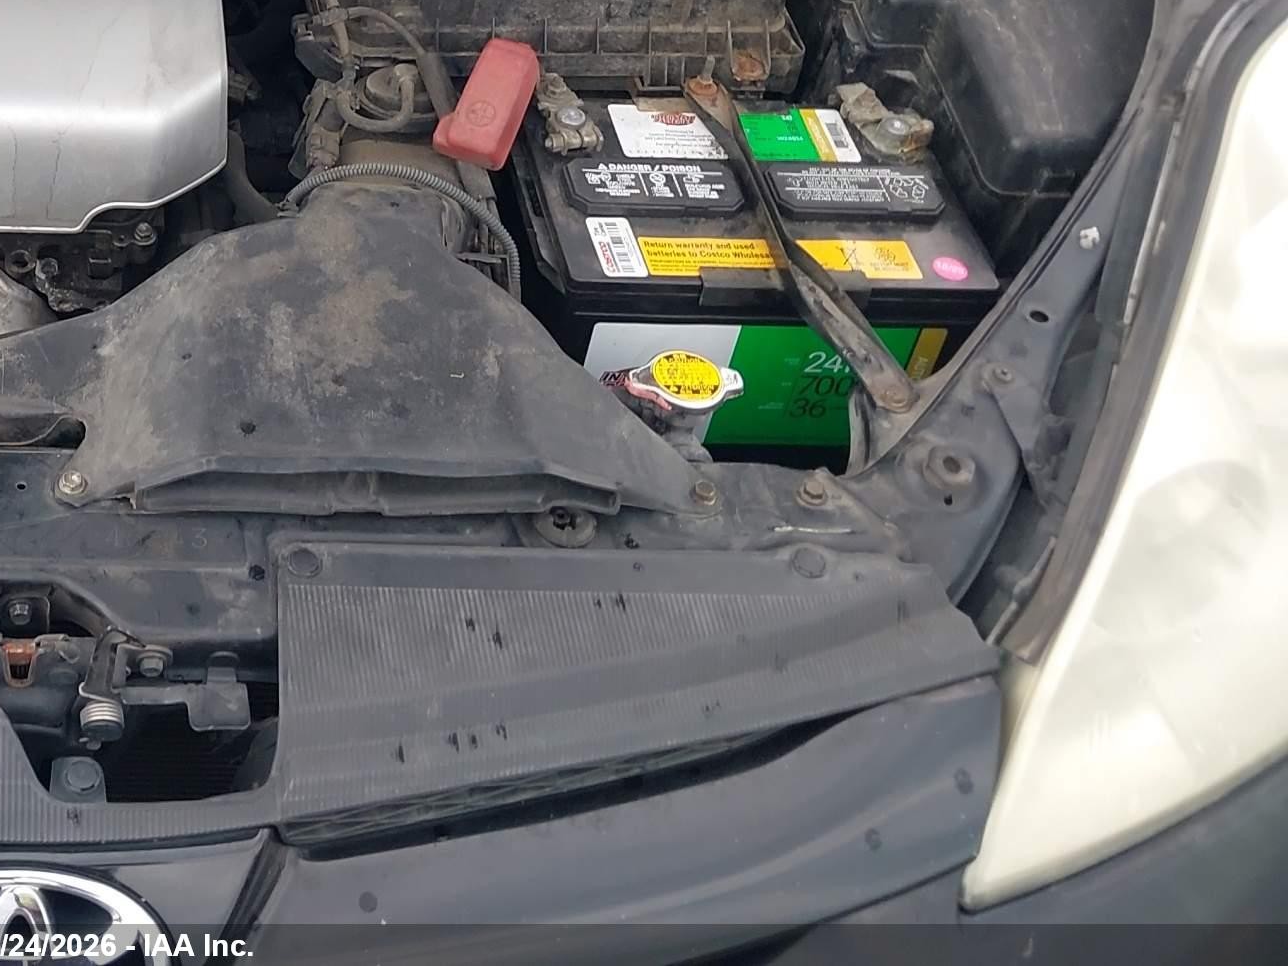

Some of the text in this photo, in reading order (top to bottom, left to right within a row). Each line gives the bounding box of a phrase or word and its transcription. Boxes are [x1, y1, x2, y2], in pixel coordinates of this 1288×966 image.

[608, 163, 652, 173] DANGER
[661, 164, 701, 173] POISON
[643, 240, 755, 251] Return warranty and used
[646, 249, 687, 258] batteries
[689, 249, 698, 258] to
[700, 250, 731, 259] Costco
[804, 351, 852, 373] 24
[789, 398, 827, 418] 36
